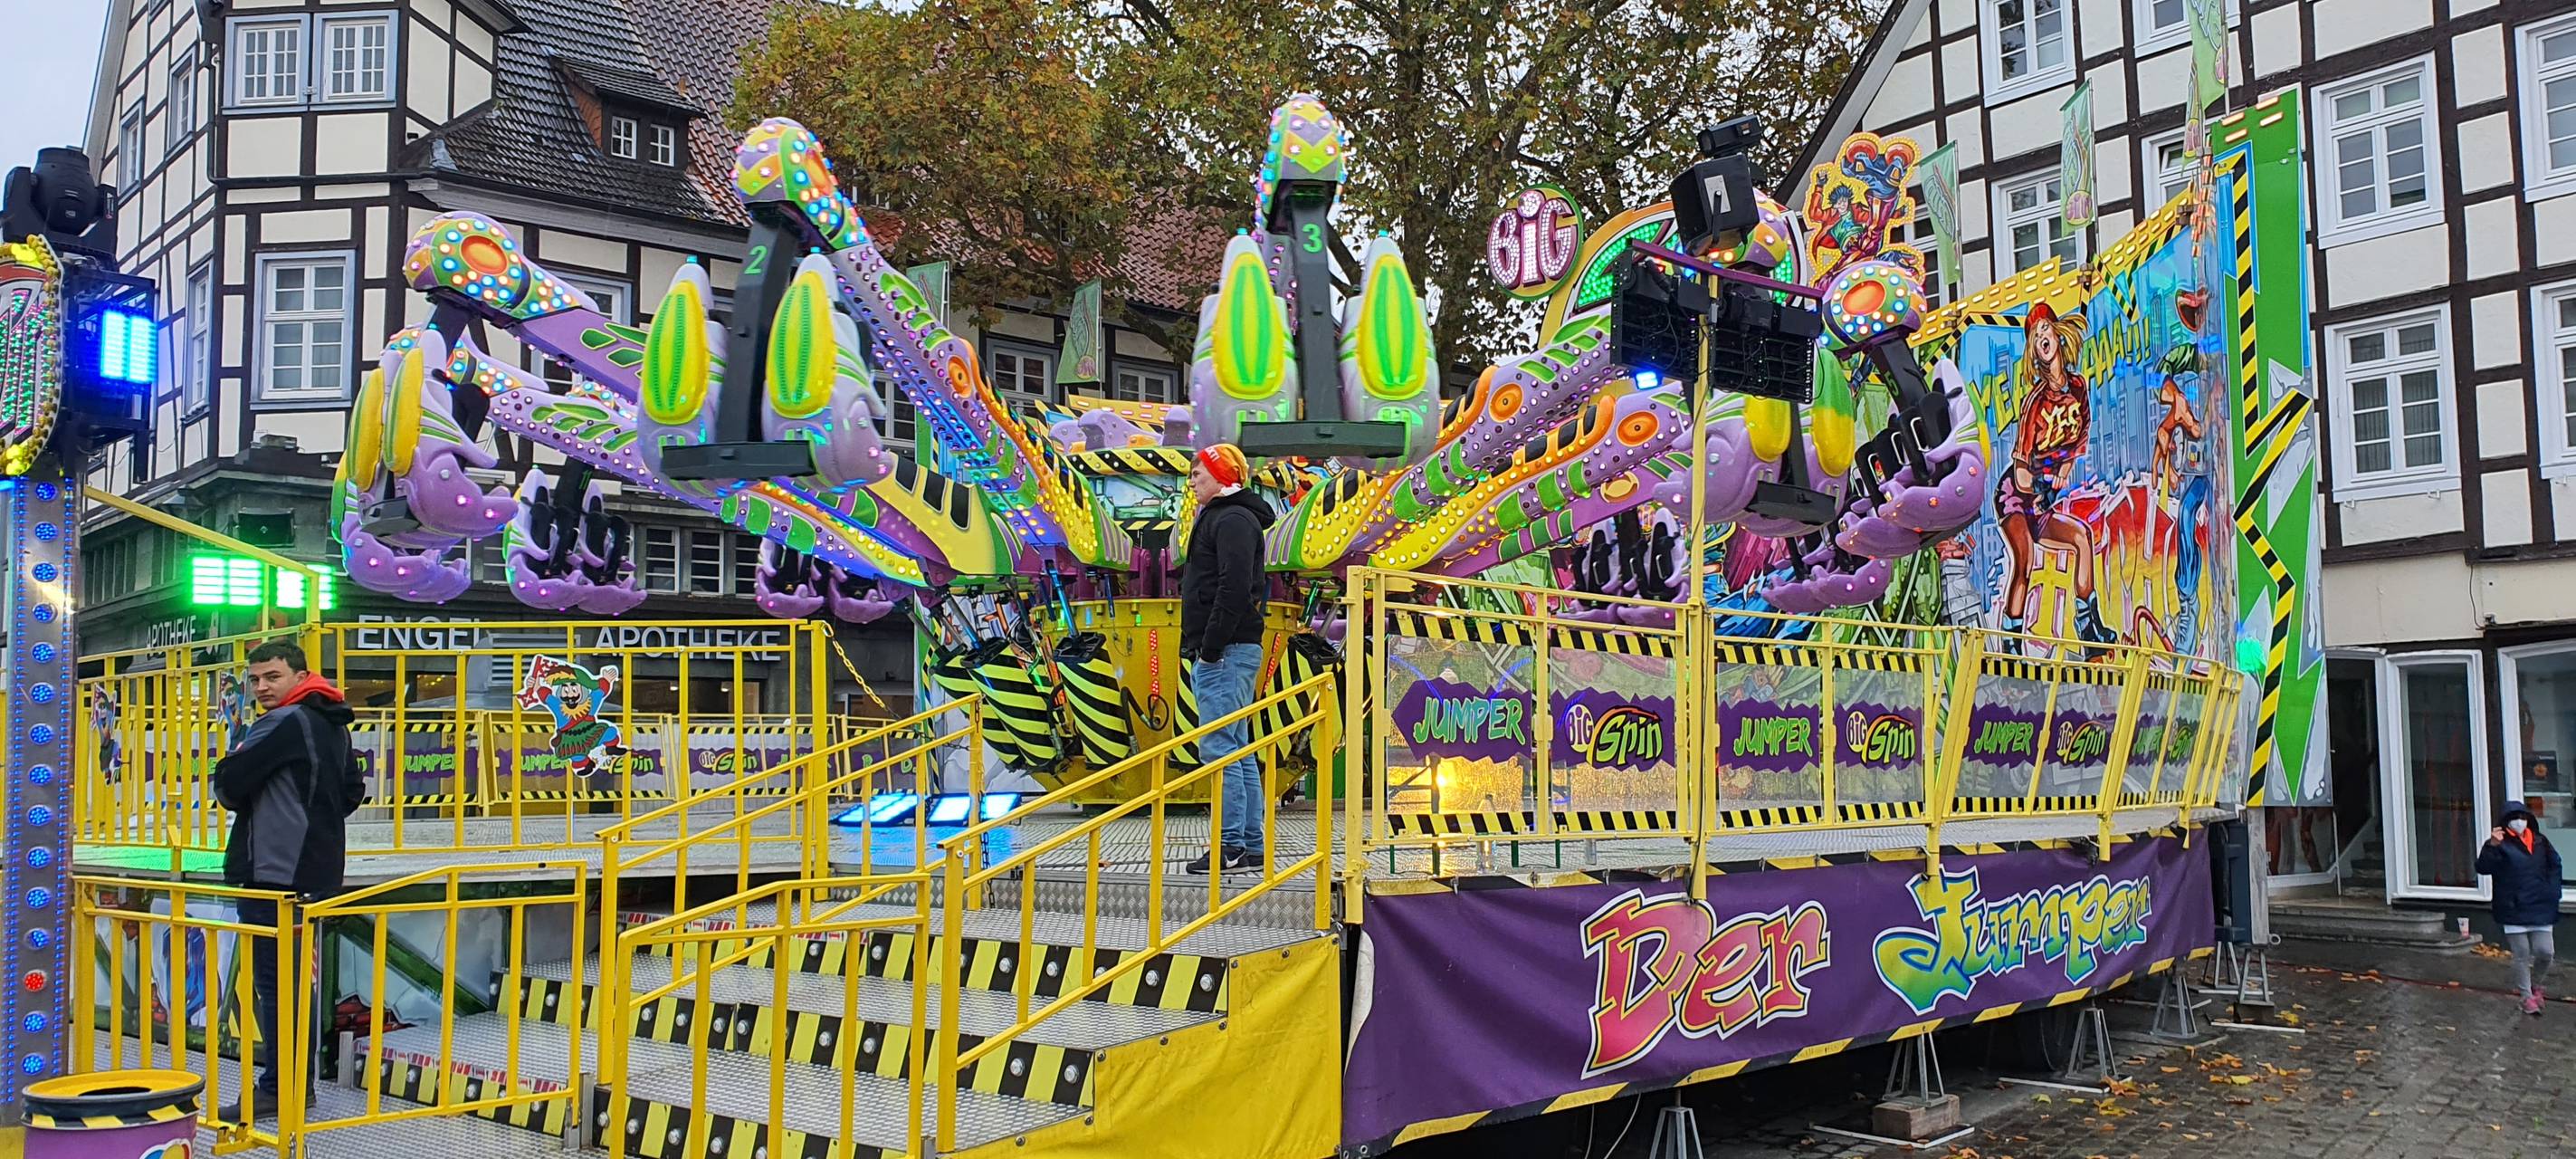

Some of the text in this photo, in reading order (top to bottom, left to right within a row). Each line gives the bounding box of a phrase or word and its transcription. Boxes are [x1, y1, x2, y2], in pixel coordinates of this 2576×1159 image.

[1302, 223, 1323, 253] 3
[744, 245, 768, 274] 2
[593, 626, 782, 662] APOTHEKE
[1413, 695, 1527, 745] JUMPER
[1596, 712, 1664, 766] Spin
[1733, 716, 1813, 757] JUMPER
[1973, 720, 2035, 757] JUMPER
[1868, 720, 1916, 764] Spin
[2068, 724, 2107, 763] Spin
[1582, 864, 2152, 1079] Der Jumper
